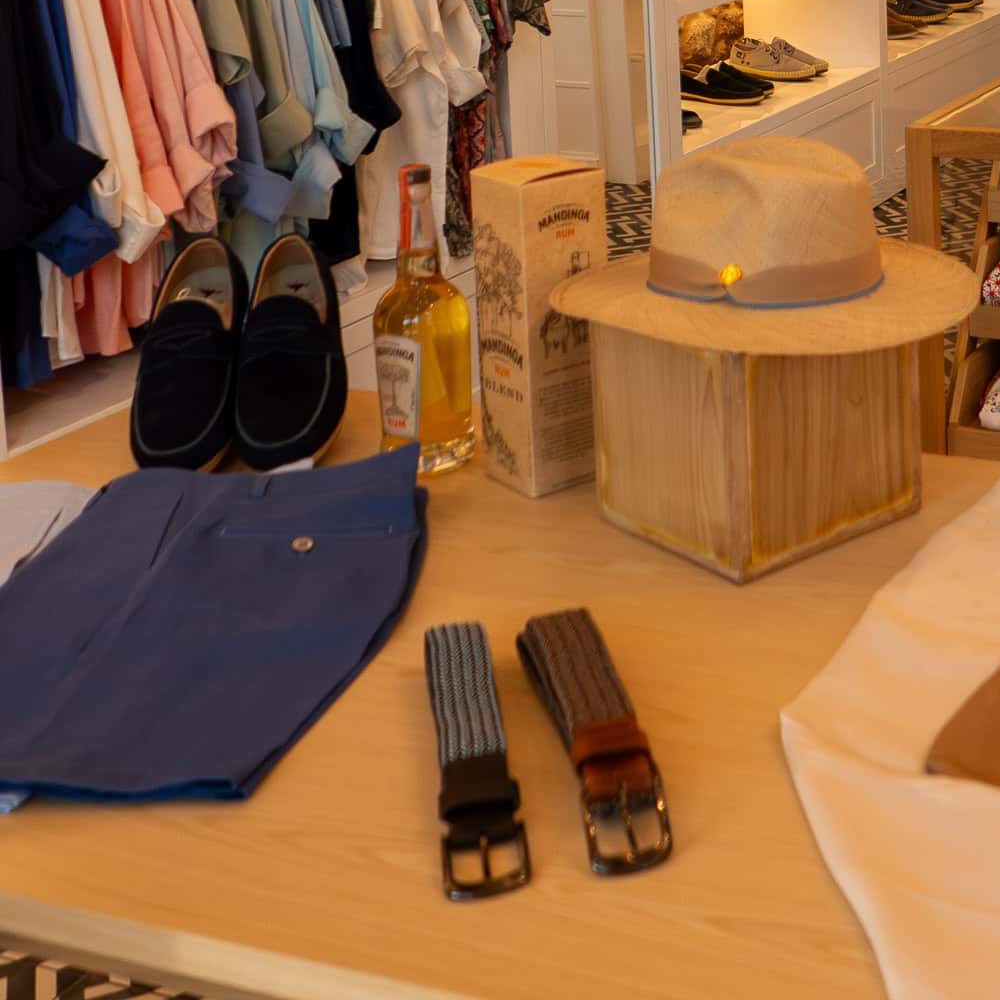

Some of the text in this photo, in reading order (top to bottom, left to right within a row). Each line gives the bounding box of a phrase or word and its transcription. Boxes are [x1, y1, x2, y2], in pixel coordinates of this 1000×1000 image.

[538, 207, 590, 232] MANDINGA
[555, 228, 575, 240] RUM
[480, 337, 523, 370] MANDINGA
